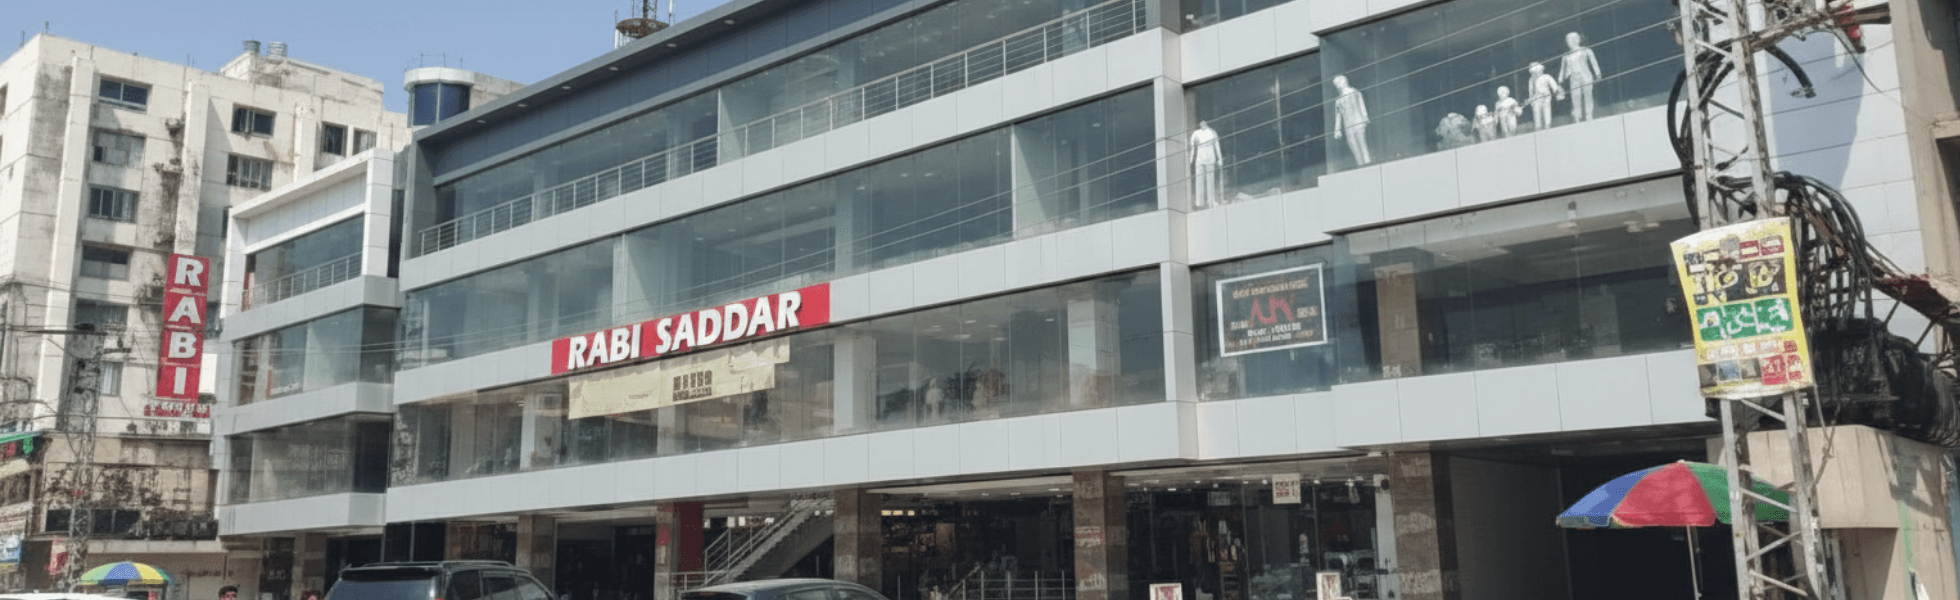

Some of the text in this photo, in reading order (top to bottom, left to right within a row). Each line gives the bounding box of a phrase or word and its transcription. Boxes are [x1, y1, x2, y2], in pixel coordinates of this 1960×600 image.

[167, 257, 204, 395] RABI
[567, 290, 802, 370] RABI SADDAR
